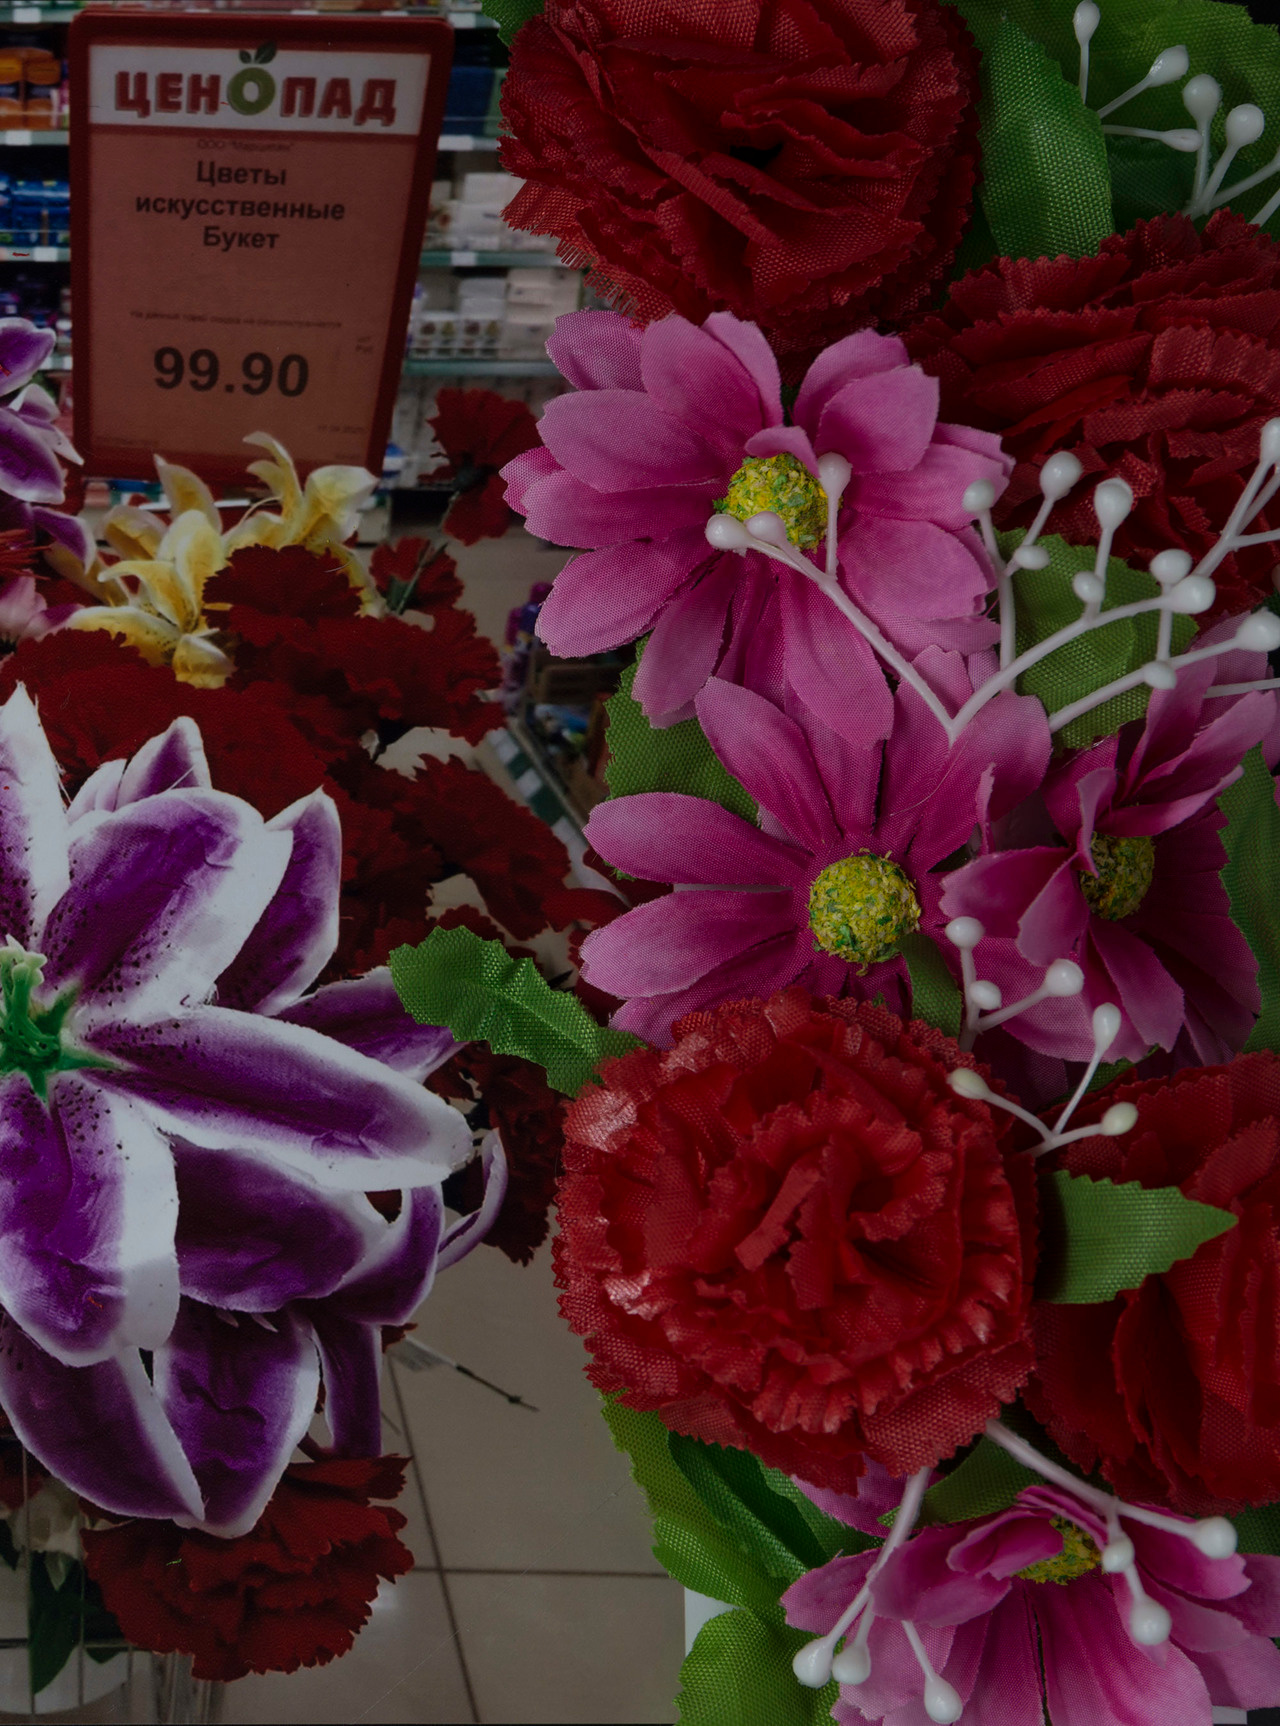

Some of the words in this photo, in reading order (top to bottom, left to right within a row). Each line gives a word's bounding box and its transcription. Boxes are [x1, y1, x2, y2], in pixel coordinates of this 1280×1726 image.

[115, 67, 397, 126] ЦЕНОПАД
[196, 160, 287, 187] Цветы
[136, 196, 345, 220] искусственные
[203, 226, 280, 251] Букет
[153, 346, 310, 397] 99.90
